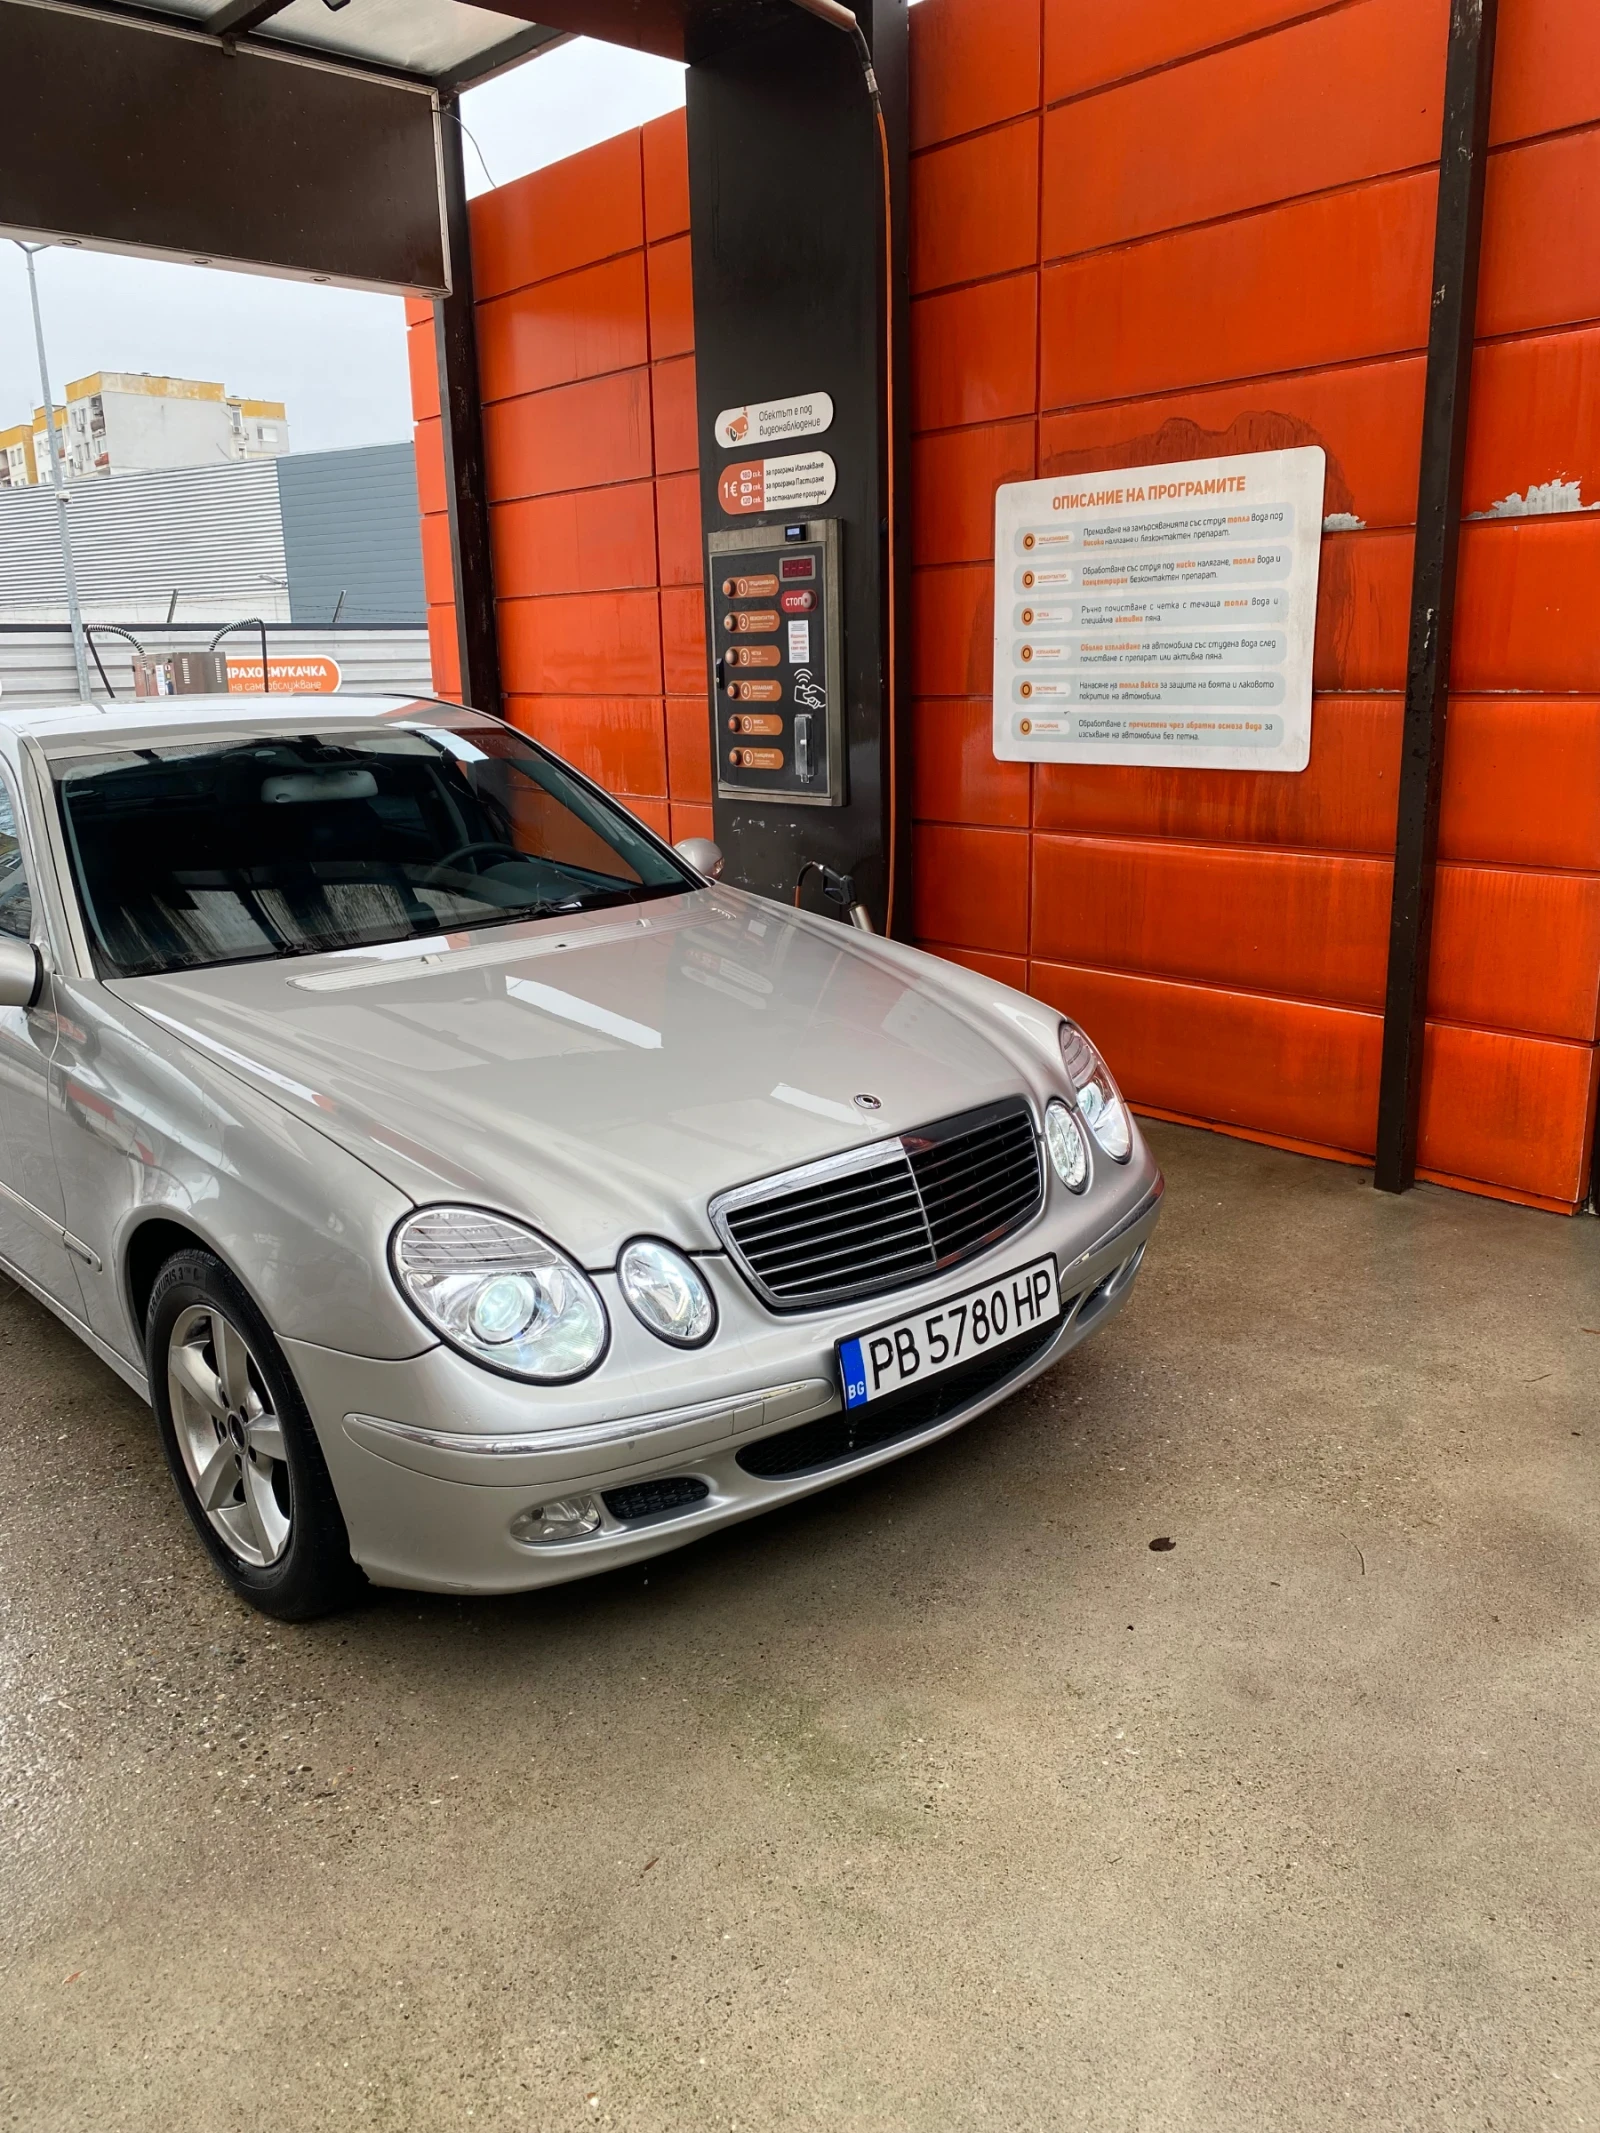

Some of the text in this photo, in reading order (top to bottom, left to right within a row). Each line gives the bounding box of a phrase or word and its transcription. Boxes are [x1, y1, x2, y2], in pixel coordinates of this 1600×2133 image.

[759, 404, 812, 422] Обектът е под
[760, 418, 820, 437] видеонаблюдение
[772, 466, 794, 476] програма
[795, 461, 824, 472] Изплакване
[772, 480, 795, 490] програма
[795, 476, 824, 486] Пастиране
[723, 481, 738, 499] 1€
[772, 493, 803, 502] останалите
[802, 489, 827, 498] програми
[1052, 476, 1246, 510] ОПИСАНИЕ НА ПРОГРАМИТЕ
[1083, 526, 1121, 537] Премахване
[1131, 520, 1188, 532] замърсяванията
[1189, 519, 1201, 527] със
[1203, 517, 1226, 527] струя
[1227, 515, 1250, 524] топла
[1251, 513, 1269, 523] вода
[1270, 512, 1283, 521] под
[1140, 532, 1191, 542] безконтактен
[1193, 529, 1230, 539] препарат.
[1082, 565, 1126, 575] Обработване
[1126, 564, 1138, 572] със
[1139, 563, 1161, 572] струя
[1162, 562, 1175, 571] под
[1176, 560, 1196, 569] ниско
[1197, 559, 1231, 568] налягане,
[1232, 557, 1256, 565] топла
[1257, 554, 1274, 565] вода
[1082, 571, 1218, 586] концентриран безконтактен препарат.
[740, 583, 744, 592] 1
[785, 597, 803, 607] СТОП
[1081, 605, 1102, 614] Ръчно
[1104, 603, 1147, 612] почистване
[1156, 601, 1180, 610] четка
[1189, 600, 1221, 609] течаща
[1223, 599, 1249, 607] топла
[1251, 597, 1270, 607] вода
[741, 617, 746, 627] 2
[1081, 616, 1113, 625] специална
[1115, 614, 1144, 623] активна
[1080, 643, 1103, 652] Обилно
[1104, 641, 1140, 651] изплакване
[1151, 641, 1193, 650] автомобила
[1194, 641, 1207, 649] със
[1208, 641, 1240, 650] студена
[1240, 639, 1258, 649] вода
[1259, 640, 1276, 649] след
[742, 652, 747, 661] 3
[1080, 654, 1118, 663] почистване
[1124, 654, 1158, 663] препарат
[1172, 652, 1204, 661] активна
[231, 683, 243, 692] на
[743, 686, 748, 695] 4
[1079, 681, 1109, 689] Нанасяне
[1140, 681, 1159, 689] вакса
[1169, 681, 1197, 690] защита
[1208, 680, 1231, 689] боята
[1238, 680, 1275, 689] лаковото
[1079, 692, 1110, 701] покритие
[1121, 692, 1162, 700] автомобила.
[745, 720, 749, 729] 5
[1078, 719, 1121, 729] Обработване
[1128, 721, 1168, 729] пречистена
[1168, 722, 1184, 730] чрез
[1186, 721, 1216, 730] обратна
[1217, 722, 1243, 730] осмоза
[1245, 721, 1262, 732] вода
[1264, 723, 1273, 731] за
[1078, 730, 1110, 738] изсъхване
[1121, 730, 1161, 739] автомобила
[1163, 731, 1174, 740] без
[746, 753, 750, 762] 6
[868, 1269, 1052, 1391] PB 5780 HP
[848, 1381, 865, 1400] BG
